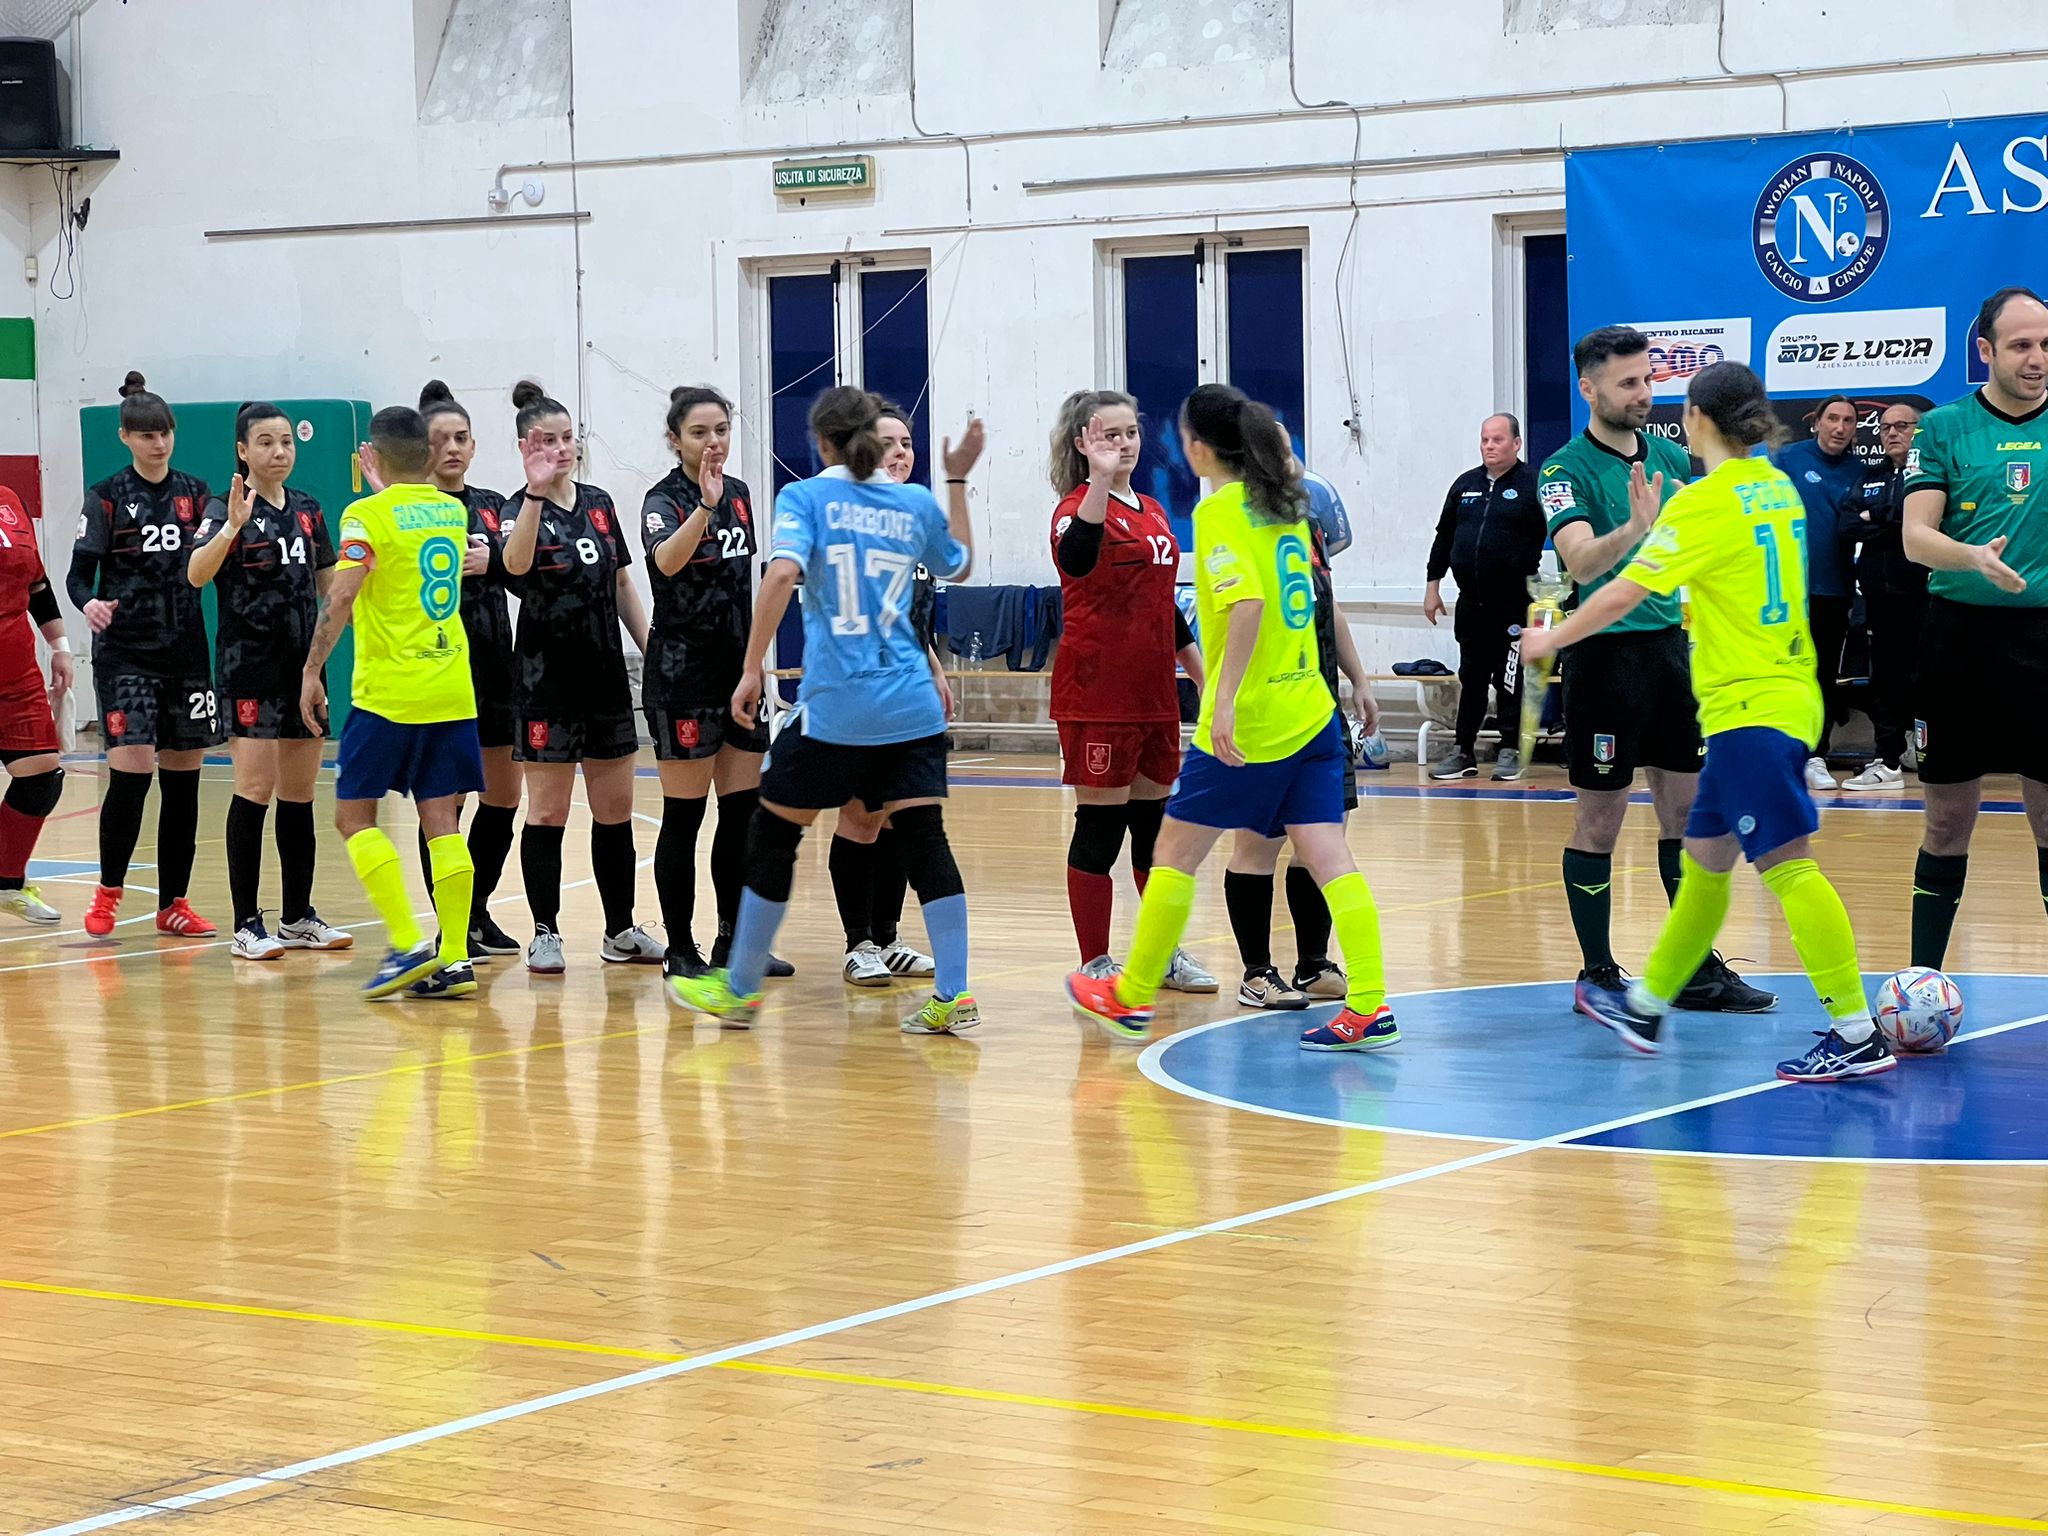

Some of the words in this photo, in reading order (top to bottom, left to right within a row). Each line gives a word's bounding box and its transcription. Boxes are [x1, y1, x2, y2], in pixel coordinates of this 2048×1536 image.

[775, 170, 804, 185] USCITA
[806, 169, 816, 183] DI
[818, 166, 862, 182] SICUREZZA
[1764, 165, 1808, 215] WOMAN
[1834, 162, 1879, 210] NAPOLI
[1765, 251, 1803, 291] CALCIO
[1835, 244, 1875, 288] CINQUE
[1680, 327, 1725, 337] RICAMBI
[1779, 334, 1818, 343] GRUPPO
[1816, 360, 1854, 369] AZIENDA
[1856, 359, 1881, 368] EDILE
[1885, 358, 1930, 366] STRADALE
[1843, 337, 1934, 361] LUCIA
[1996, 442, 2042, 451] LEGEA
[825, 501, 915, 542] CARBONE
[141, 523, 181, 552] 28
[276, 536, 307, 565] 14
[575, 537, 600, 565] 8
[717, 526, 749, 559] 22
[1146, 535, 1174, 565] 12
[419, 536, 459, 621] 8
[826, 543, 914, 639] 17
[1276, 534, 1313, 629] 6
[1503, 639, 1521, 695] LEGEA
[188, 690, 216, 719] 28
